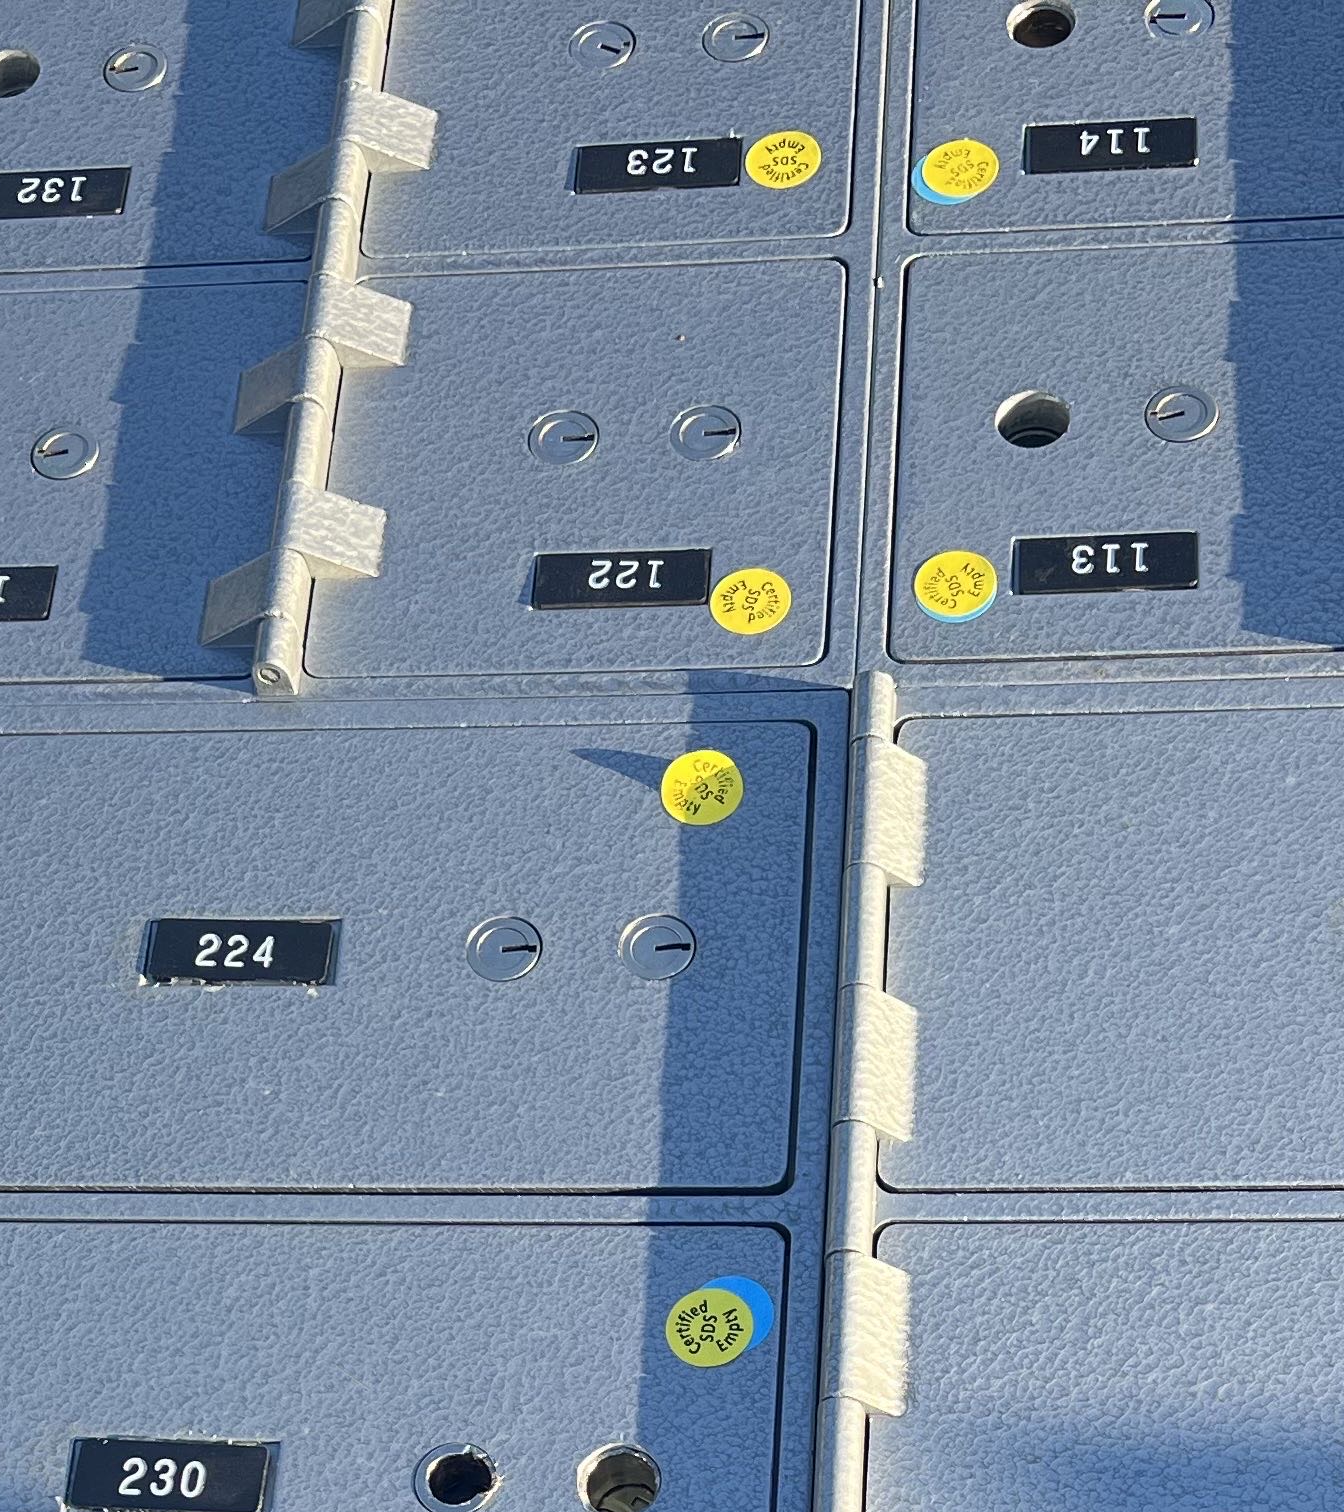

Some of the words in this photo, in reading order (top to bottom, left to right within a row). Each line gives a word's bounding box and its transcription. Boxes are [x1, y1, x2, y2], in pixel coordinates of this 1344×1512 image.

[764, 138, 806, 154] Empty
[1079, 127, 1150, 155] 114
[626, 147, 698, 176] 123
[758, 161, 809, 183] Certified
[772, 155, 797, 166] SDS
[16, 176, 87, 204] 132
[1071, 542, 1150, 574] 113
[588, 559, 665, 589] 122
[923, 567, 957, 610] Certified
[945, 575, 964, 598] SDS
[959, 562, 985, 598] Empty
[720, 580, 748, 613] Empty
[742, 588, 761, 612] SDS
[747, 581, 781, 624] Certified
[674, 779, 701, 815] Empty
[690, 775, 714, 801] SDS
[693, 759, 735, 805] Certified
[194, 933, 275, 968] 224
[676, 1300, 708, 1354] Certified
[699, 1315, 717, 1342] SDS
[716, 1308, 744, 1352] Empty
[117, 1457, 206, 1498] 230
